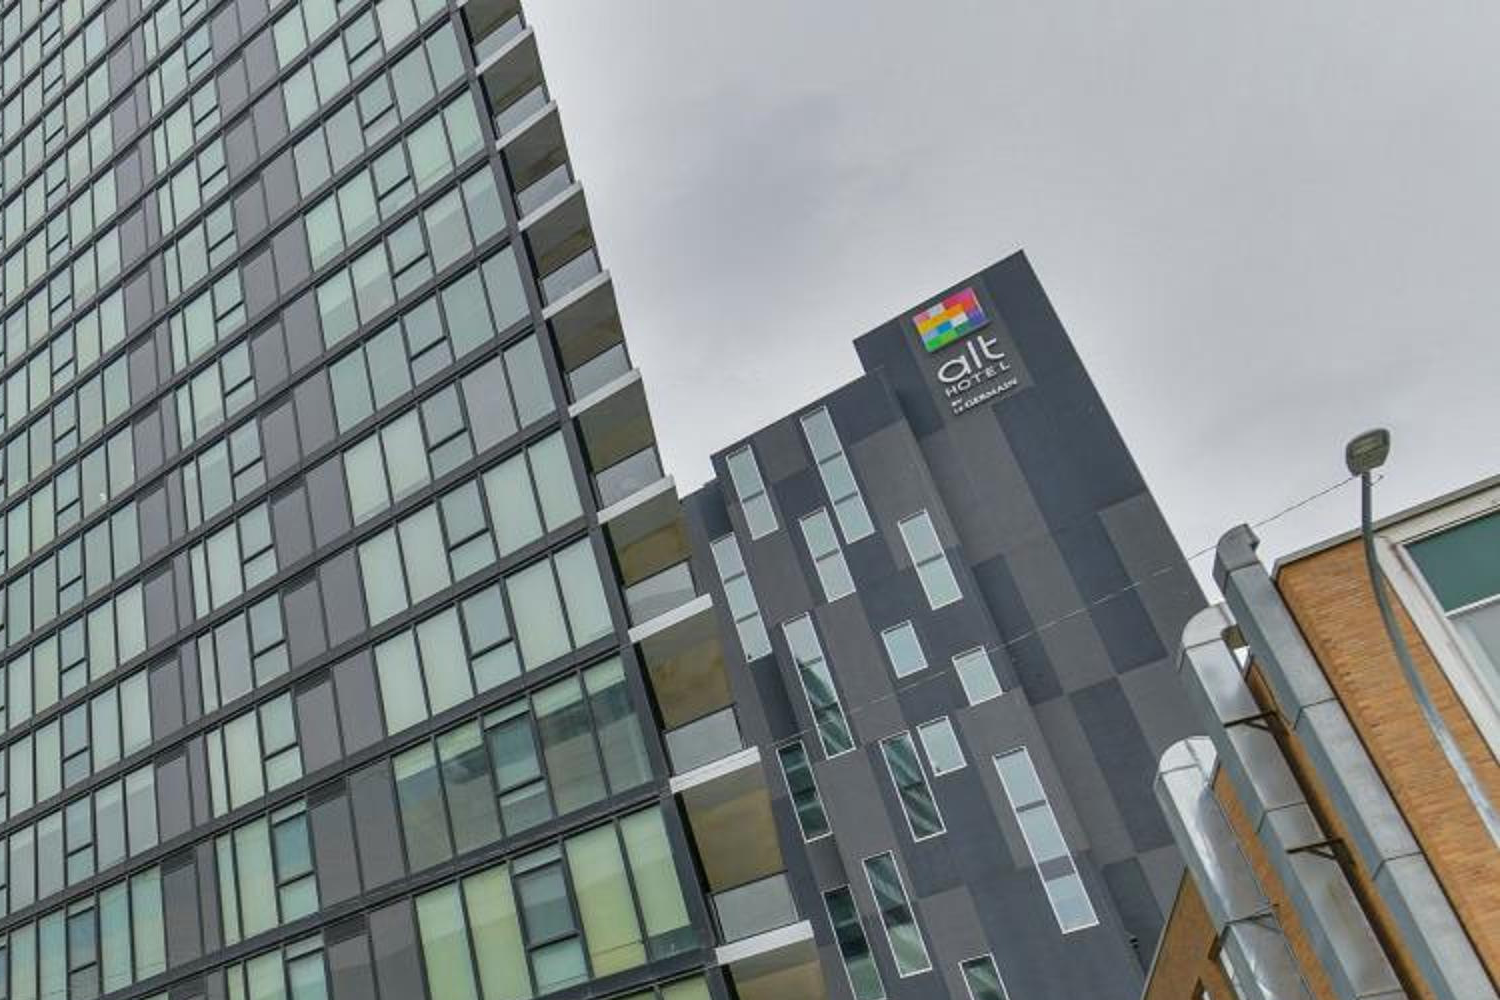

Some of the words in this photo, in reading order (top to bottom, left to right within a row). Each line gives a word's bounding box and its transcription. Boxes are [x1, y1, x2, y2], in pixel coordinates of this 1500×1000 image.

[937, 335, 1005, 382] alt
[945, 361, 1011, 397] HOTEL
[964, 377, 1017, 408] GERMAIN
